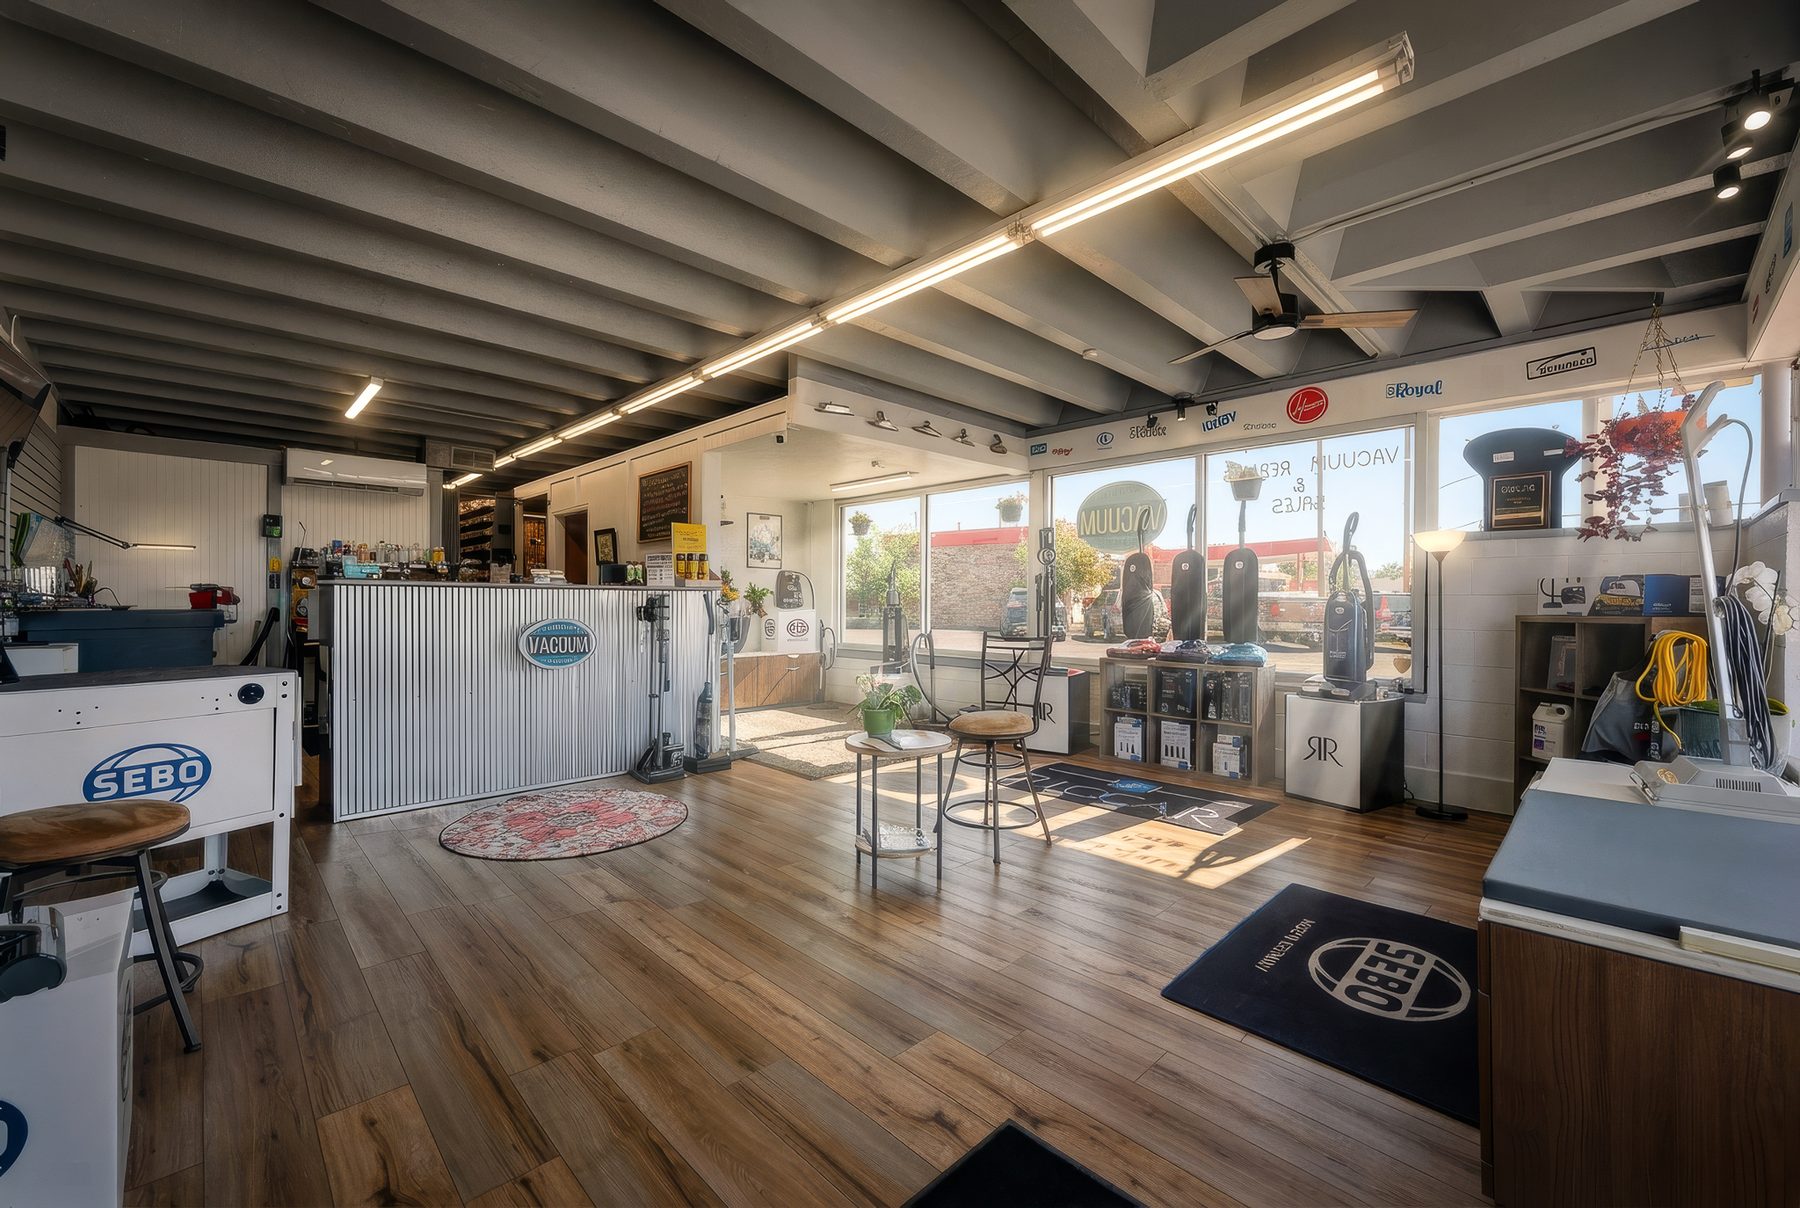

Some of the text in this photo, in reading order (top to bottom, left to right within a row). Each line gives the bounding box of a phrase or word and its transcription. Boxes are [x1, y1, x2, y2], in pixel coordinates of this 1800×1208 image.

[528, 636, 589, 654] VACUUM
[92, 759, 204, 799] SEBO
[1344, 942, 1426, 1012] SEBO
